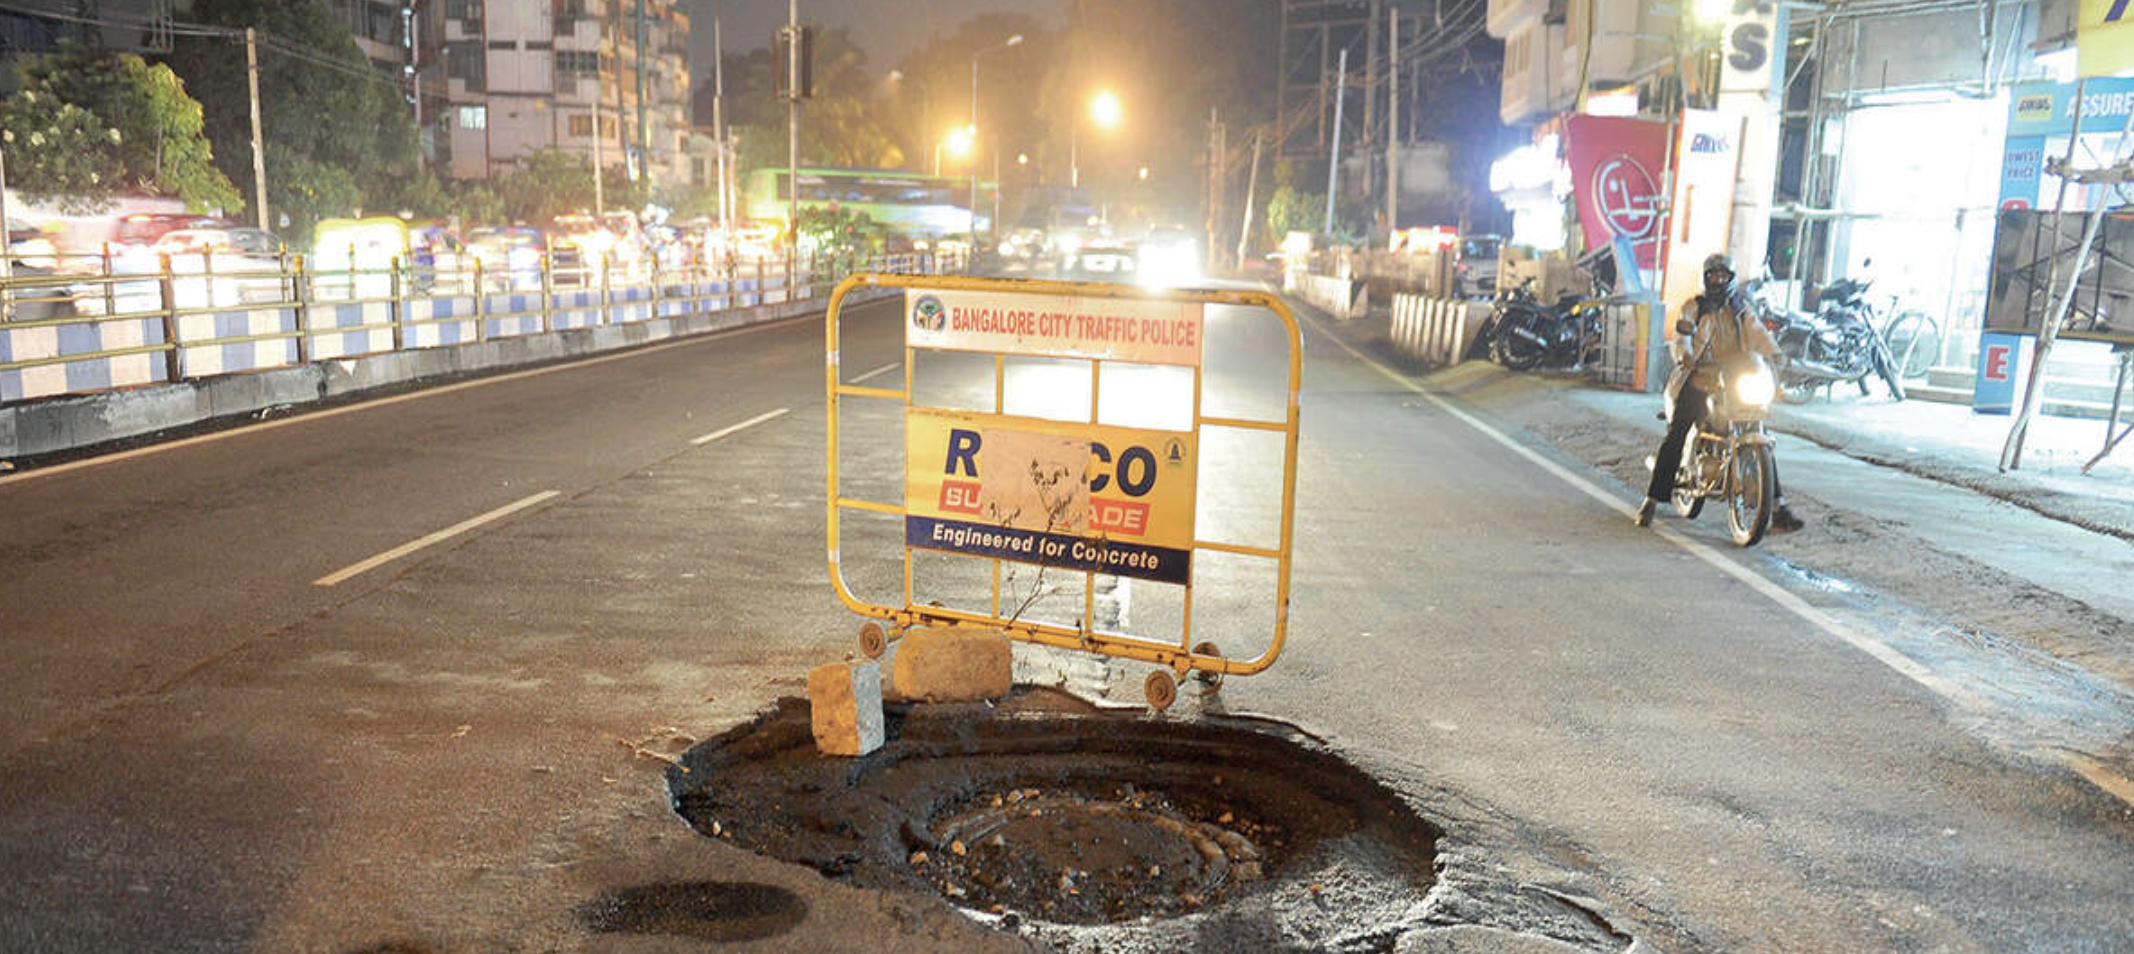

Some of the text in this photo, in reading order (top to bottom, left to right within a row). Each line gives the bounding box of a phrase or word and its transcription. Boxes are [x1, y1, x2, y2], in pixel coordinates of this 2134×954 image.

[952, 306, 1196, 347] BANGALORE CITY TRAFFIC POLICE
[933, 523, 1159, 570] Engineered for Concrete
